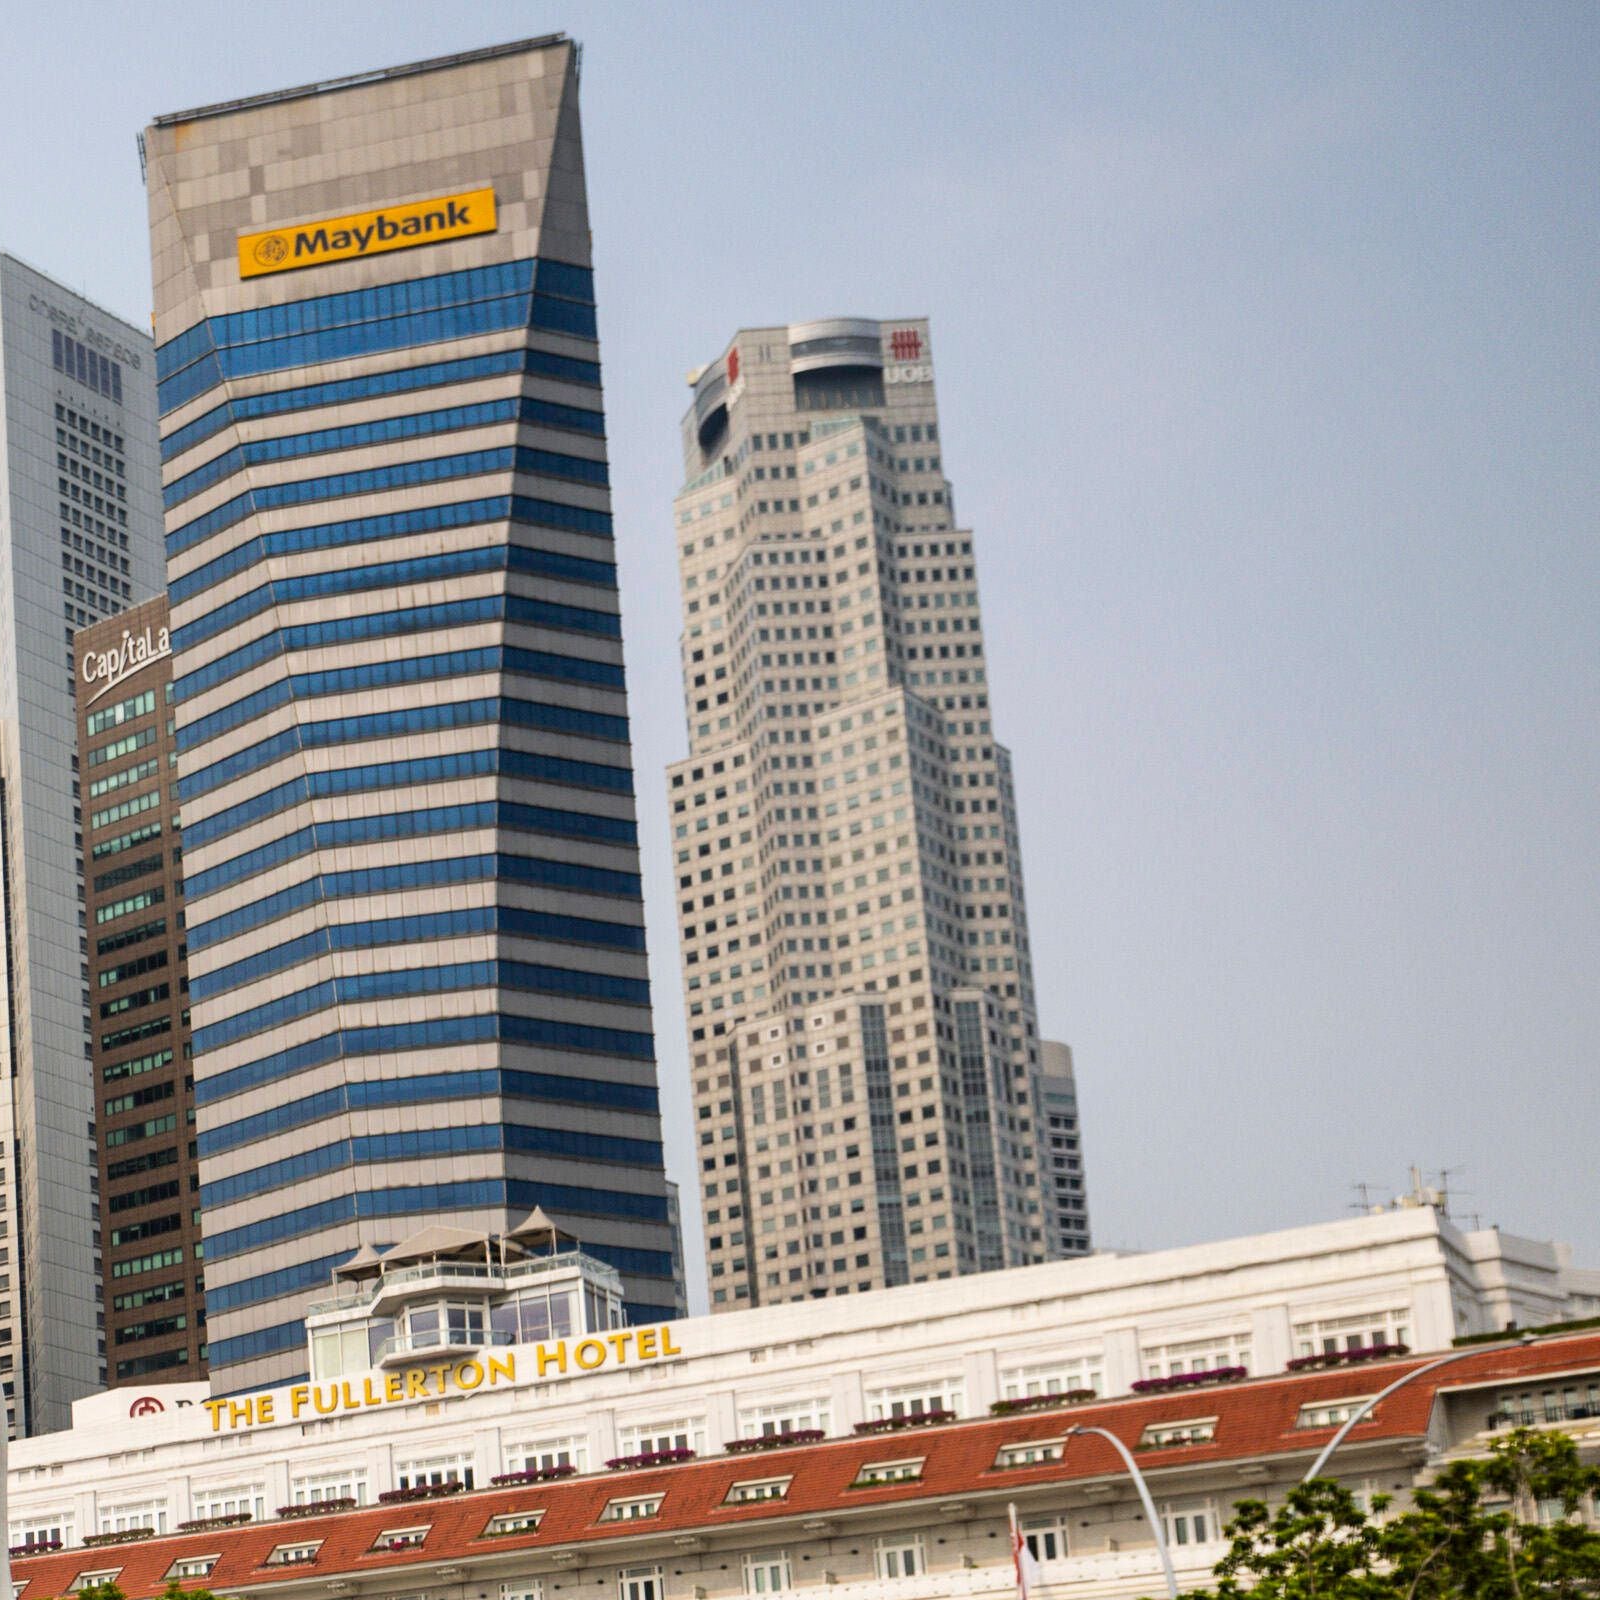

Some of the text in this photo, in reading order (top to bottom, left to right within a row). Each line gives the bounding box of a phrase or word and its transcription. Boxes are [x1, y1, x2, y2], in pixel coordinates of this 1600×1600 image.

[294, 201, 471, 258] Maybank
[883, 365, 934, 385] UOB
[204, 1326, 682, 1431] THE FULLERTON HOTEL
